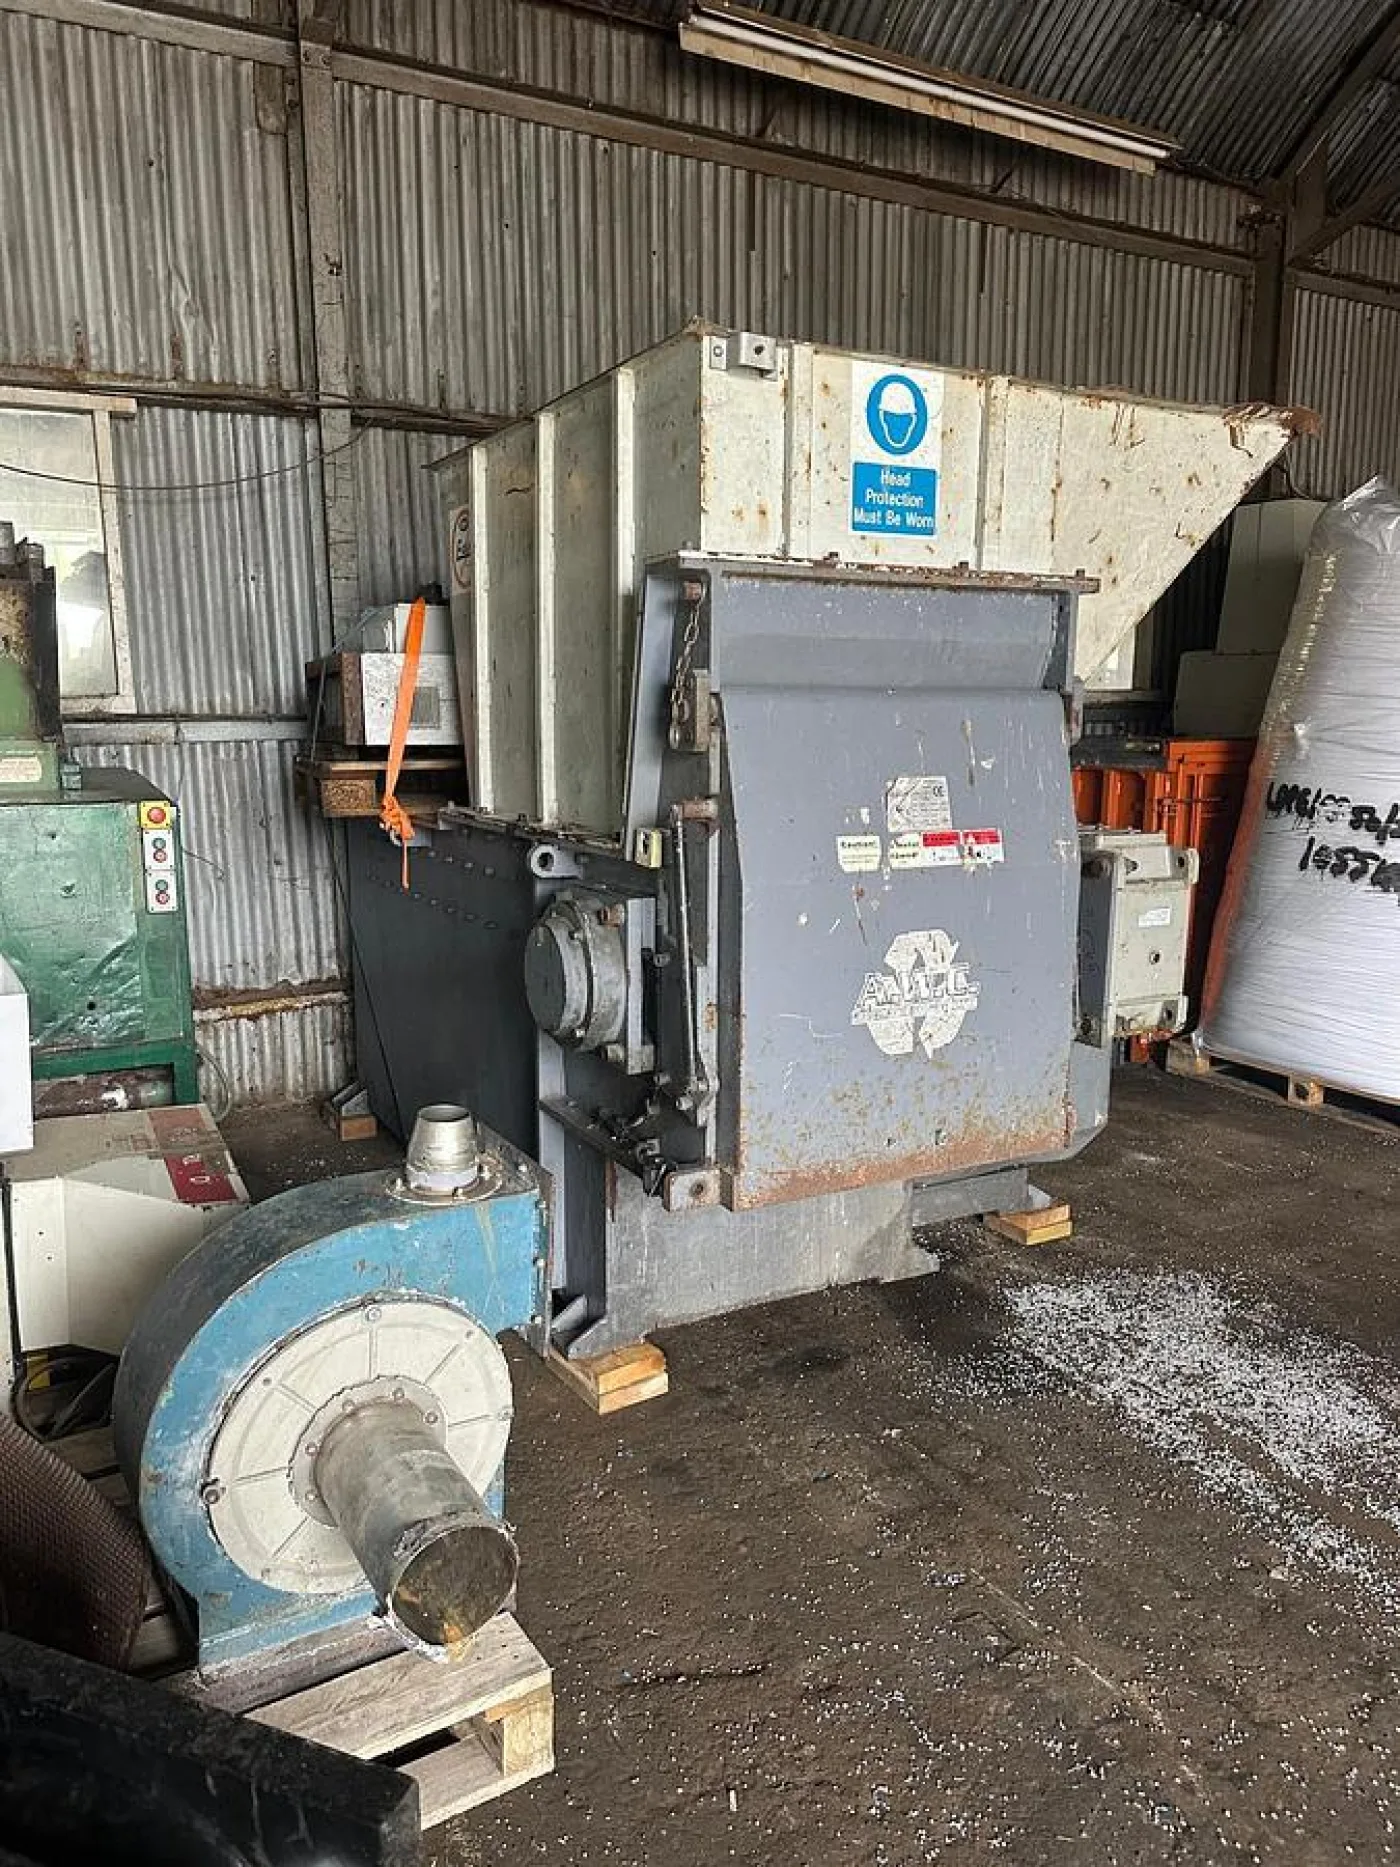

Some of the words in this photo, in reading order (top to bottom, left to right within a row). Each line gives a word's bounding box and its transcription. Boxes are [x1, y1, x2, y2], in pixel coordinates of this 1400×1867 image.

[881, 468, 911, 487] Head
[865, 488, 924, 508] Protection
[854, 507, 882, 525] Must
[886, 509, 901, 526] Be
[905, 512, 935, 528] Worn
